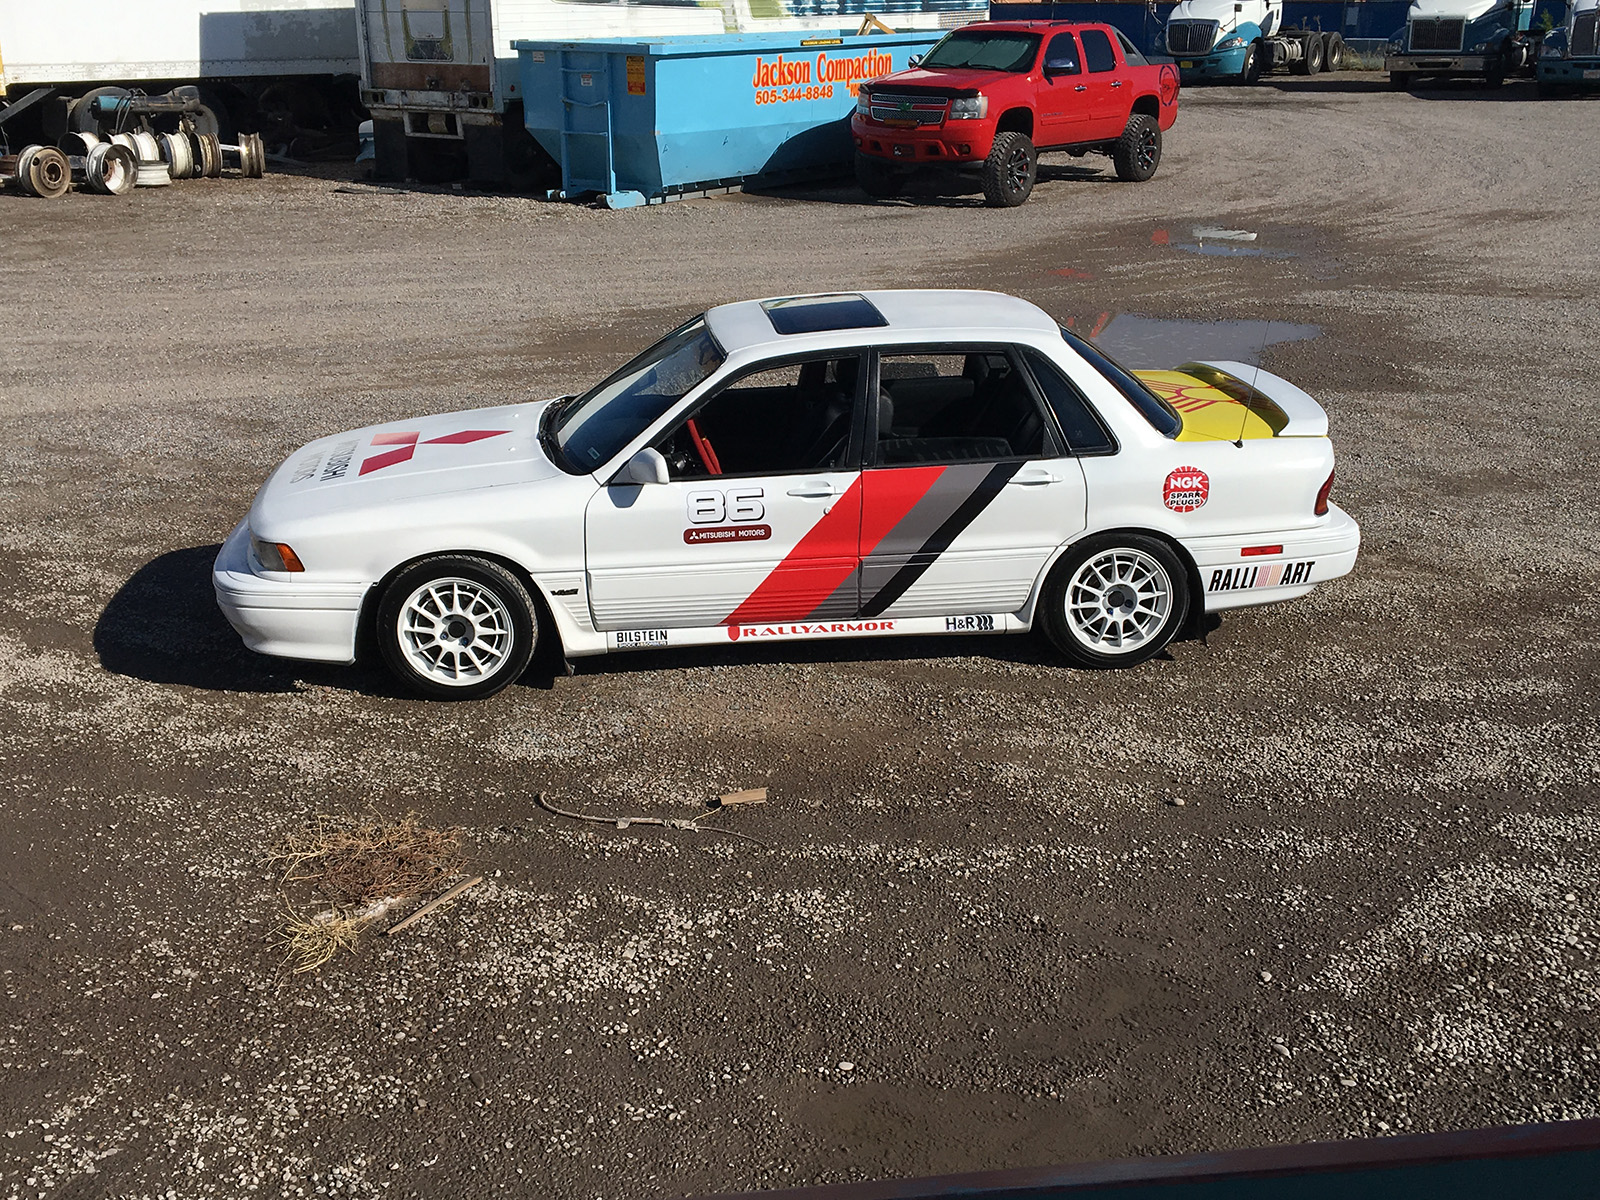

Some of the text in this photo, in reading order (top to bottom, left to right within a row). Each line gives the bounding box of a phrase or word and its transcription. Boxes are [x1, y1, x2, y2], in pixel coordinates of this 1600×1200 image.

[753, 47, 892, 89] Jackson Compaction
[755, 85, 833, 105] 505-344-8848
[1170, 476, 1203, 489] NGK
[1170, 491, 1200, 499] SPARK
[686, 487, 765, 524] 86
[699, 529, 765, 539] MITSUBISHI MOTORS
[1208, 561, 1316, 592] RALLI ART
[743, 621, 895, 637] RALLYARMOR
[945, 616, 975, 630] H&R
[616, 630, 668, 643] BILSTEIN
